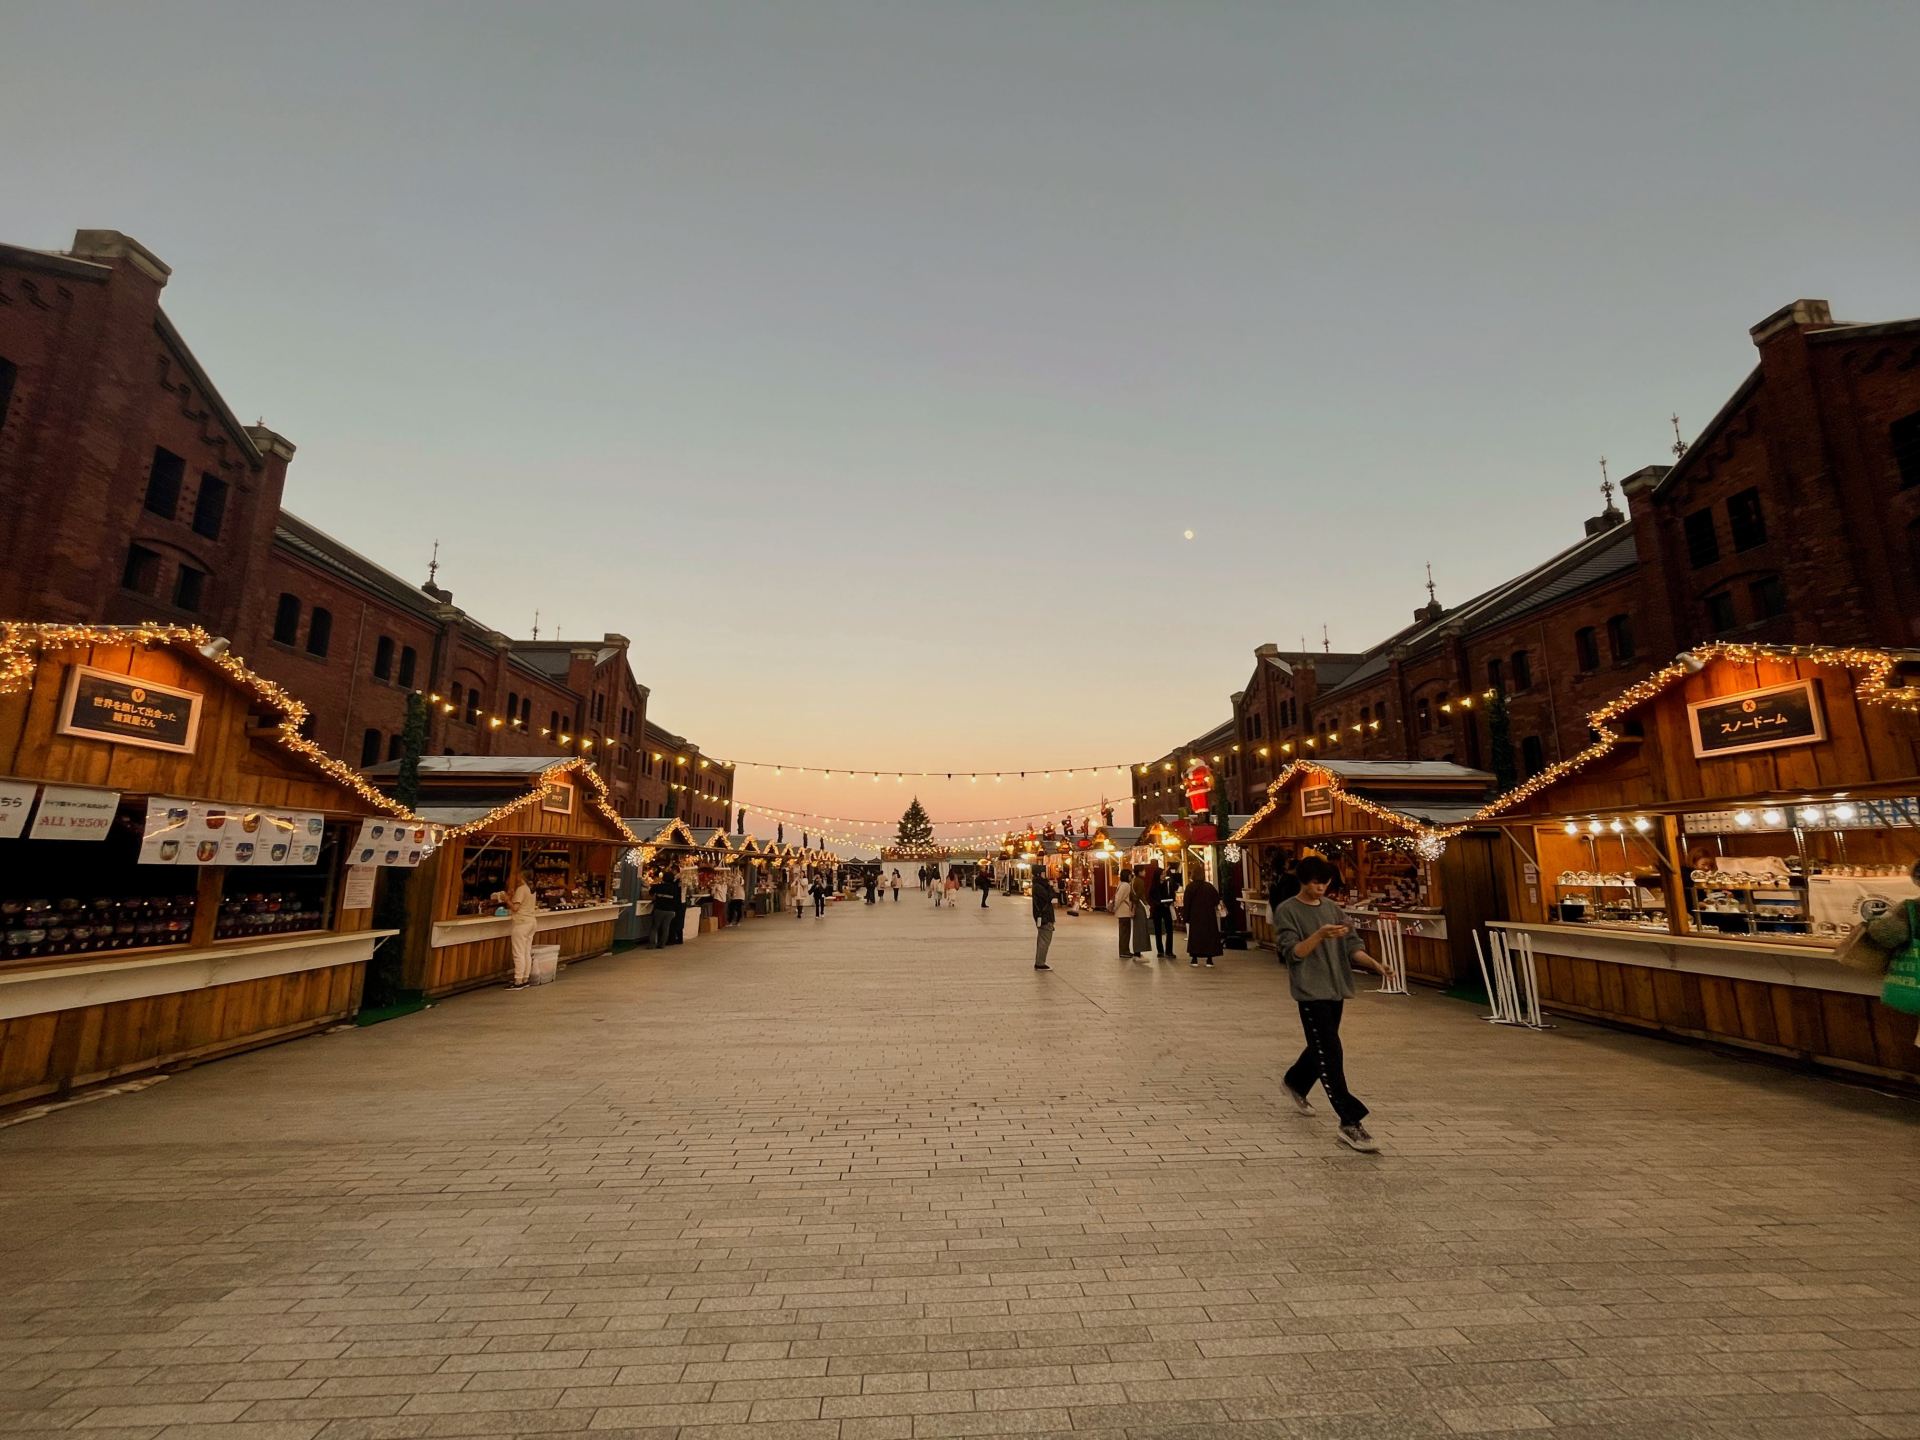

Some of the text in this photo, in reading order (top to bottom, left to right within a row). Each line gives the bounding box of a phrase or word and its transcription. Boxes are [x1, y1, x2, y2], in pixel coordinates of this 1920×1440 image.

[1720, 713, 1788, 734] スノードーム
[38, 815, 65, 827] ALL
